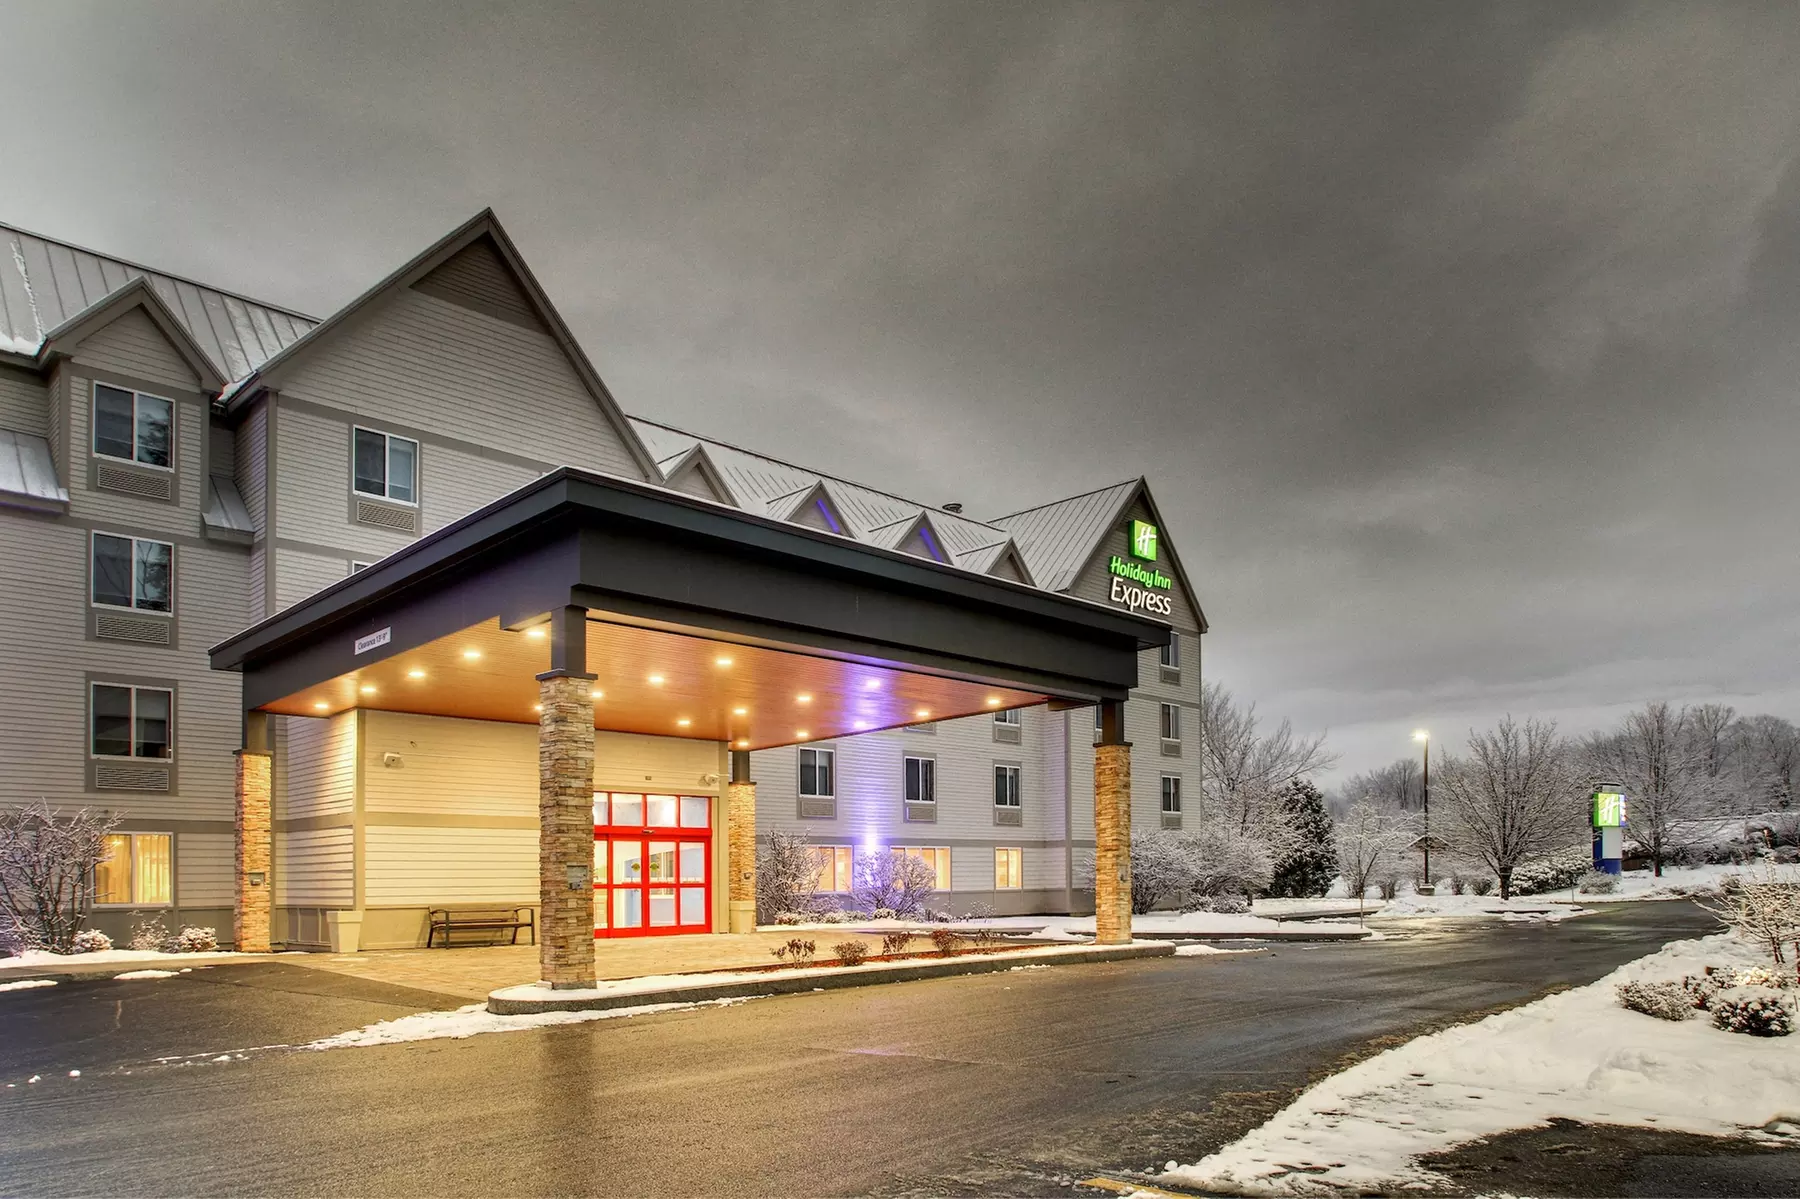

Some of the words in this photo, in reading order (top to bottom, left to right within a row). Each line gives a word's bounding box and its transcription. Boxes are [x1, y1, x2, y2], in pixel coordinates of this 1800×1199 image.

[1110, 555, 1153, 588] Holiday
[1153, 569, 1171, 589] Inn
[1111, 576, 1172, 615] Express
